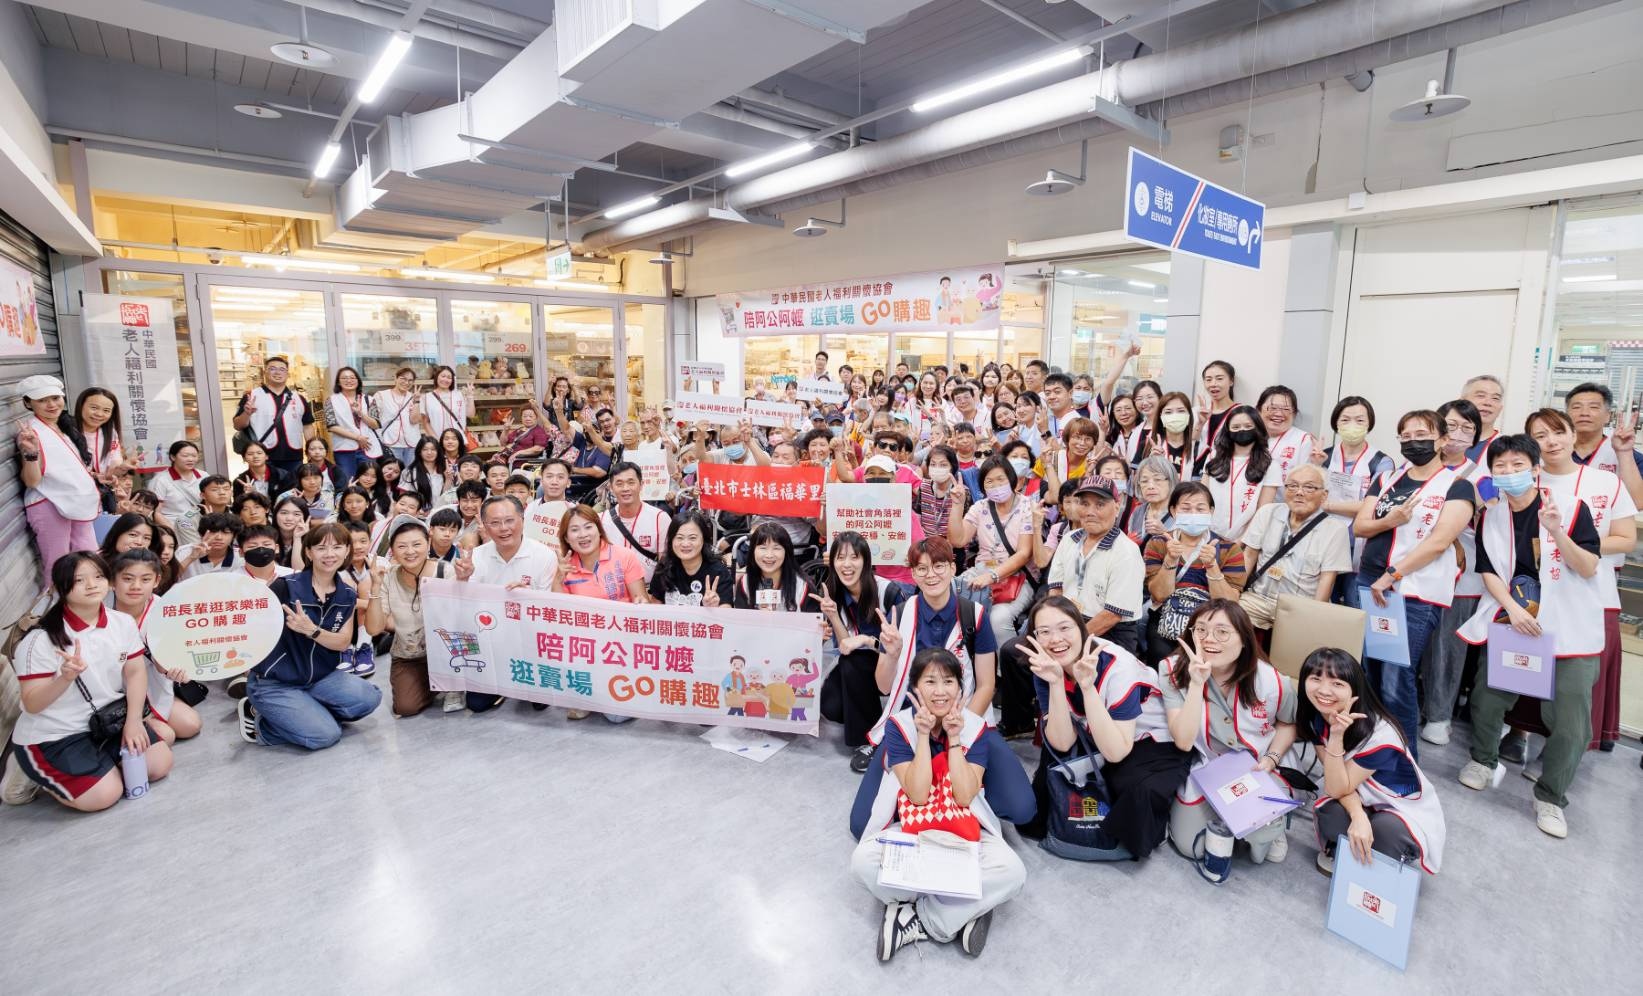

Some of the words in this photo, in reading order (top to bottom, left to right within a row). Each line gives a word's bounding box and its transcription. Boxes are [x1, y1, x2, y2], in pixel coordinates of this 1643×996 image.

[1154, 186, 1174, 213] 電梯
[1150, 210, 1173, 226] ELEVATOR
[782, 281, 894, 304] 中華民國老人福利關懷協會
[810, 304, 855, 327] 逛賣場
[142, 330, 157, 369] 中華民國
[505, 343, 527, 353] 269
[122, 329, 149, 440] 老人福利關懷協會
[701, 477, 821, 501] 臺北市士林區福華里
[162, 597, 269, 618] 陪長輩逛家樂福
[526, 605, 724, 640] 中華民國老人福利關懷協會
[536, 632, 694, 674] 陪阿公阿嬤
[509, 658, 593, 696] 逛賣場
